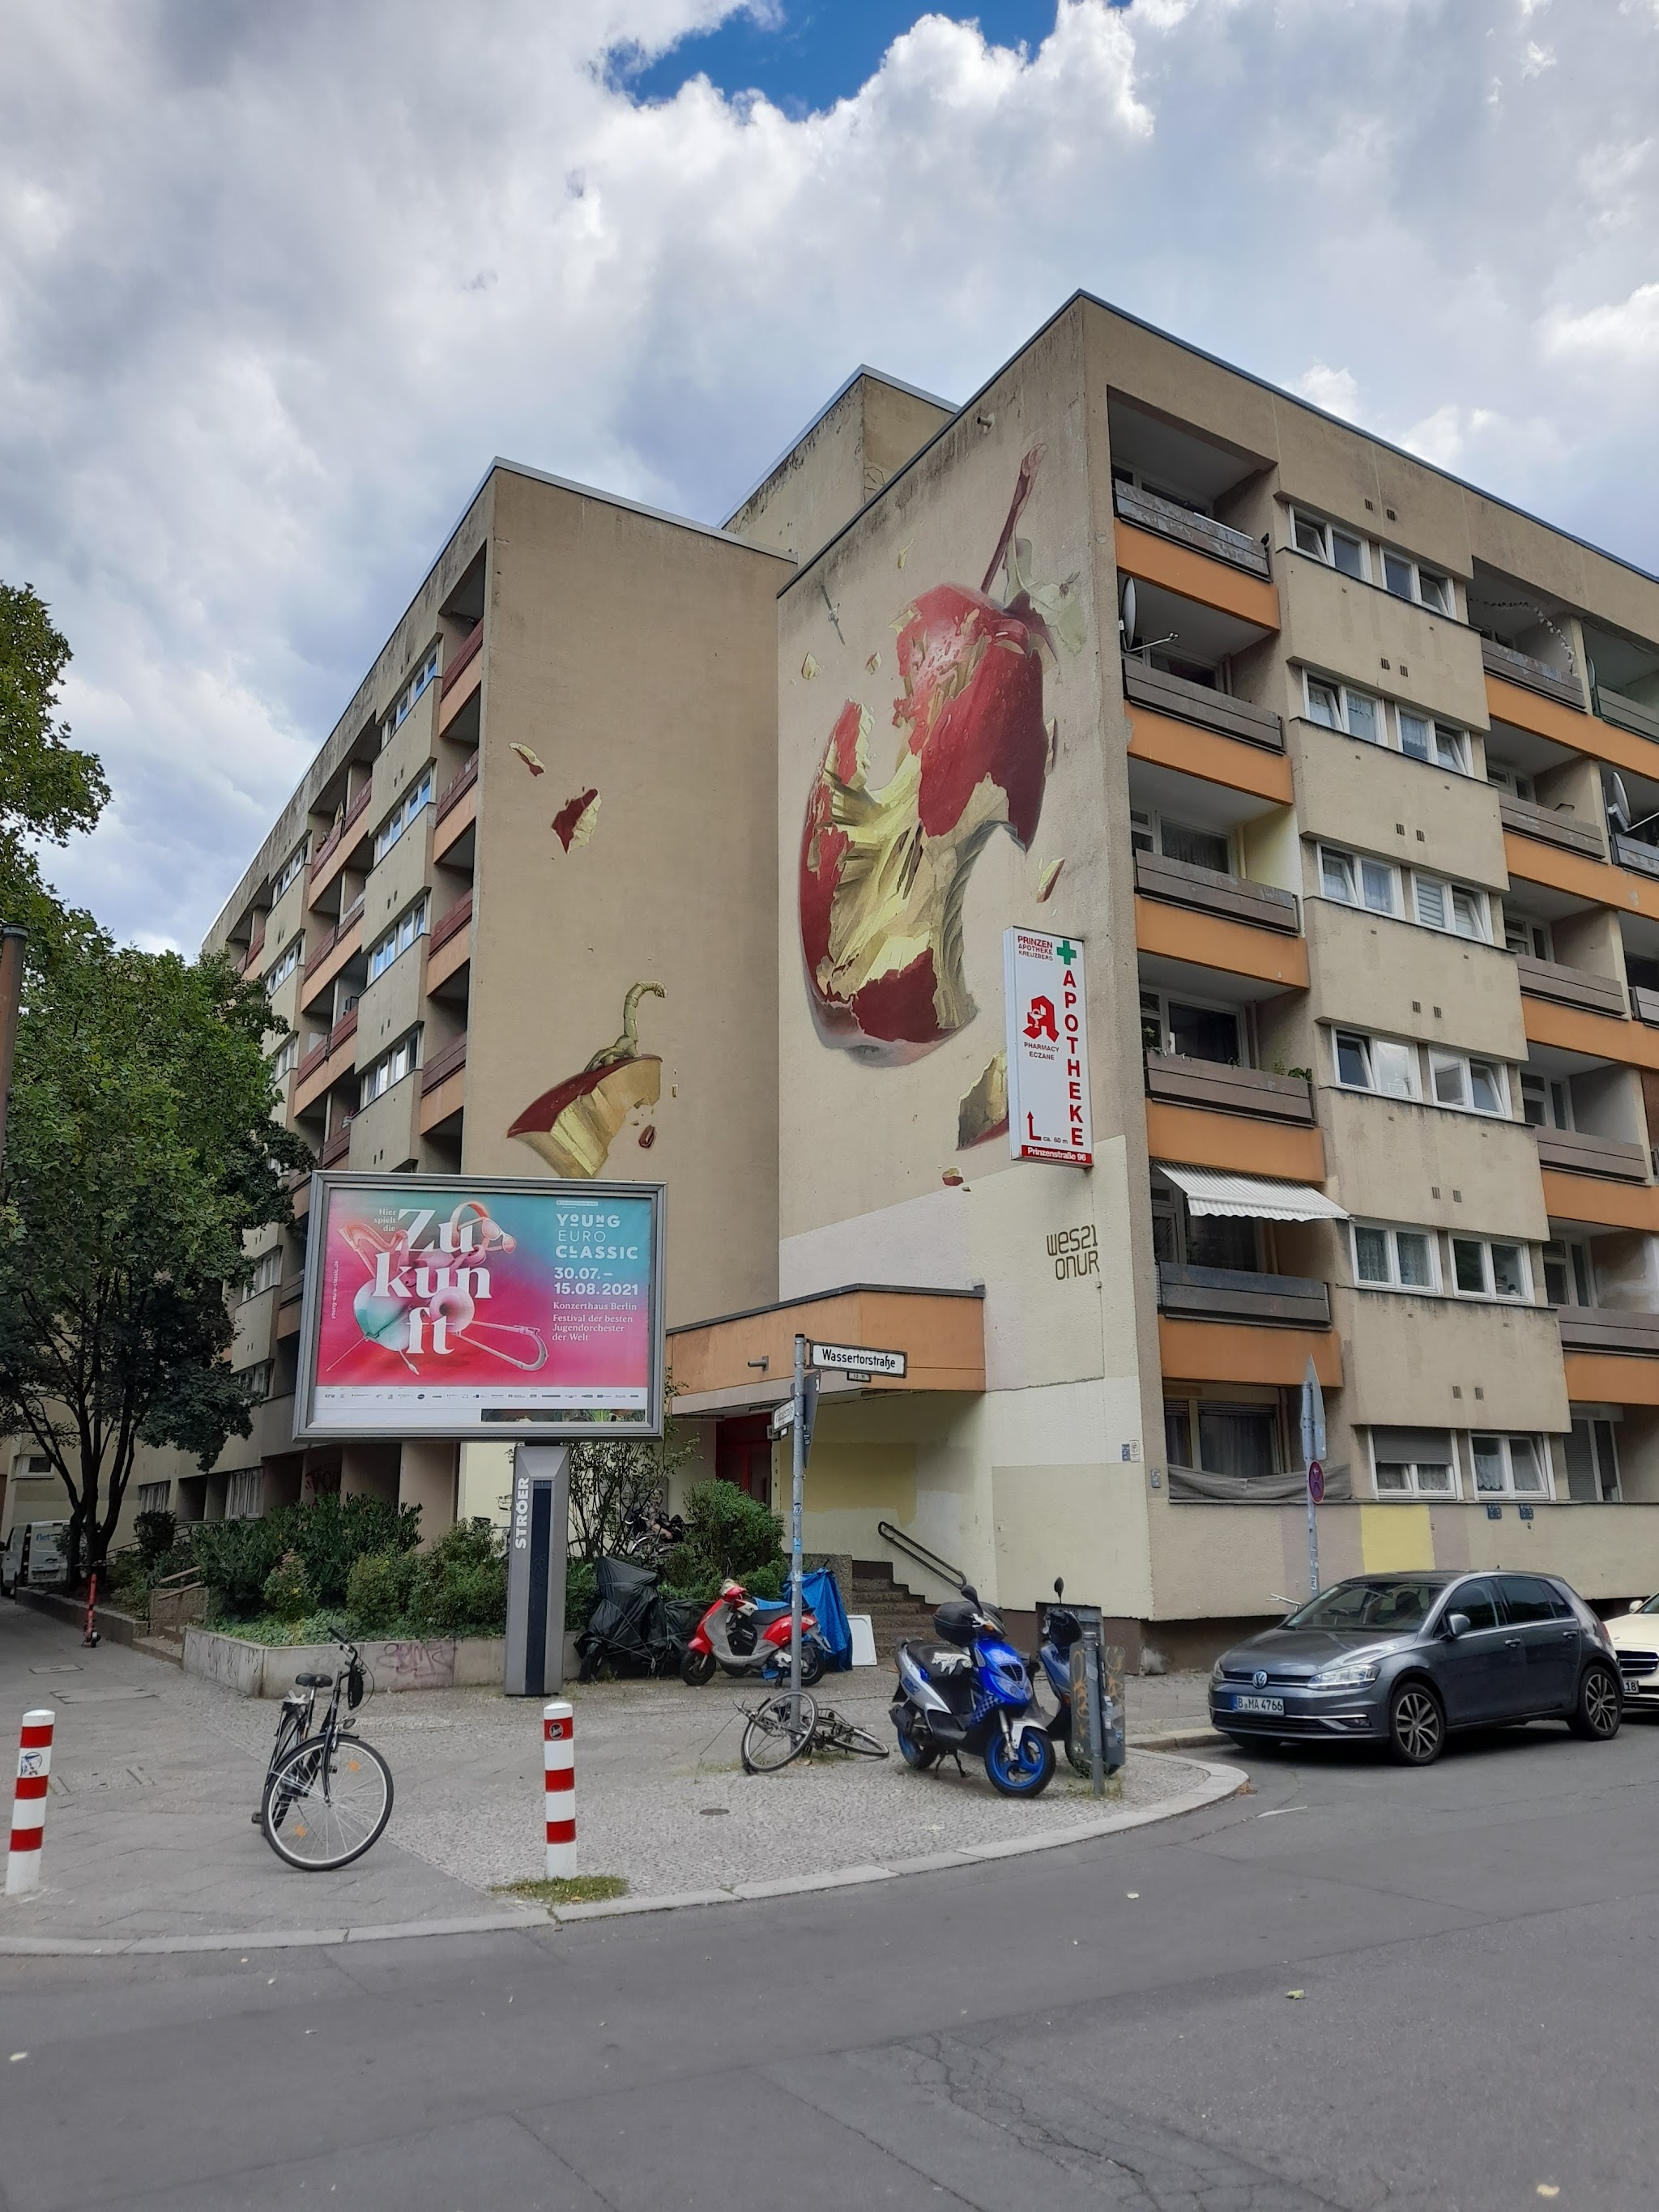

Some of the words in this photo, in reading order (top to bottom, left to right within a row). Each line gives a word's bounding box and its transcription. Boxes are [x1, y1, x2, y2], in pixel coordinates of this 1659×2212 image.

[1017, 935, 1053, 948] PRINZEN
[1018, 944, 1053, 955] APOTHEKE
[1018, 950, 1053, 961] KREUZBERG
[1024, 1042, 1060, 1053] PHARMACY
[1029, 1051, 1056, 1061] ECZANE
[1063, 970, 1084, 1146] APOTHEKE
[1027, 1147, 1076, 1160] Prinzenstraße
[1077, 1153, 1086, 1161] 96
[378, 1208, 396, 1216] Hier
[556, 1213, 621, 1228] YOUNG
[382, 1224, 396, 1232] die
[394, 1208, 475, 1253] Zu
[558, 1230, 606, 1242] EURO
[555, 1245, 638, 1259] CLASSIC
[373, 1251, 493, 1299] kun
[331, 1259, 339, 1320] young-euro-classic.de
[553, 1282, 638, 1296] 15.08.2021
[552, 1302, 608, 1310] Konzerthaus
[611, 1302, 637, 1311] Berlin
[552, 1314, 586, 1322] Festival
[587, 1315, 603, 1323] der
[604, 1315, 633, 1323] besten
[406, 1306, 455, 1355] ft
[552, 1323, 625, 1333] Jugendorchester
[552, 1332, 567, 1340] der
[569, 1333, 589, 1341] Welt
[822, 1348, 896, 1370] Wassertorstraße
[514, 1477, 530, 1549] STRÖER
[1238, 1698, 1243, 1707] B
